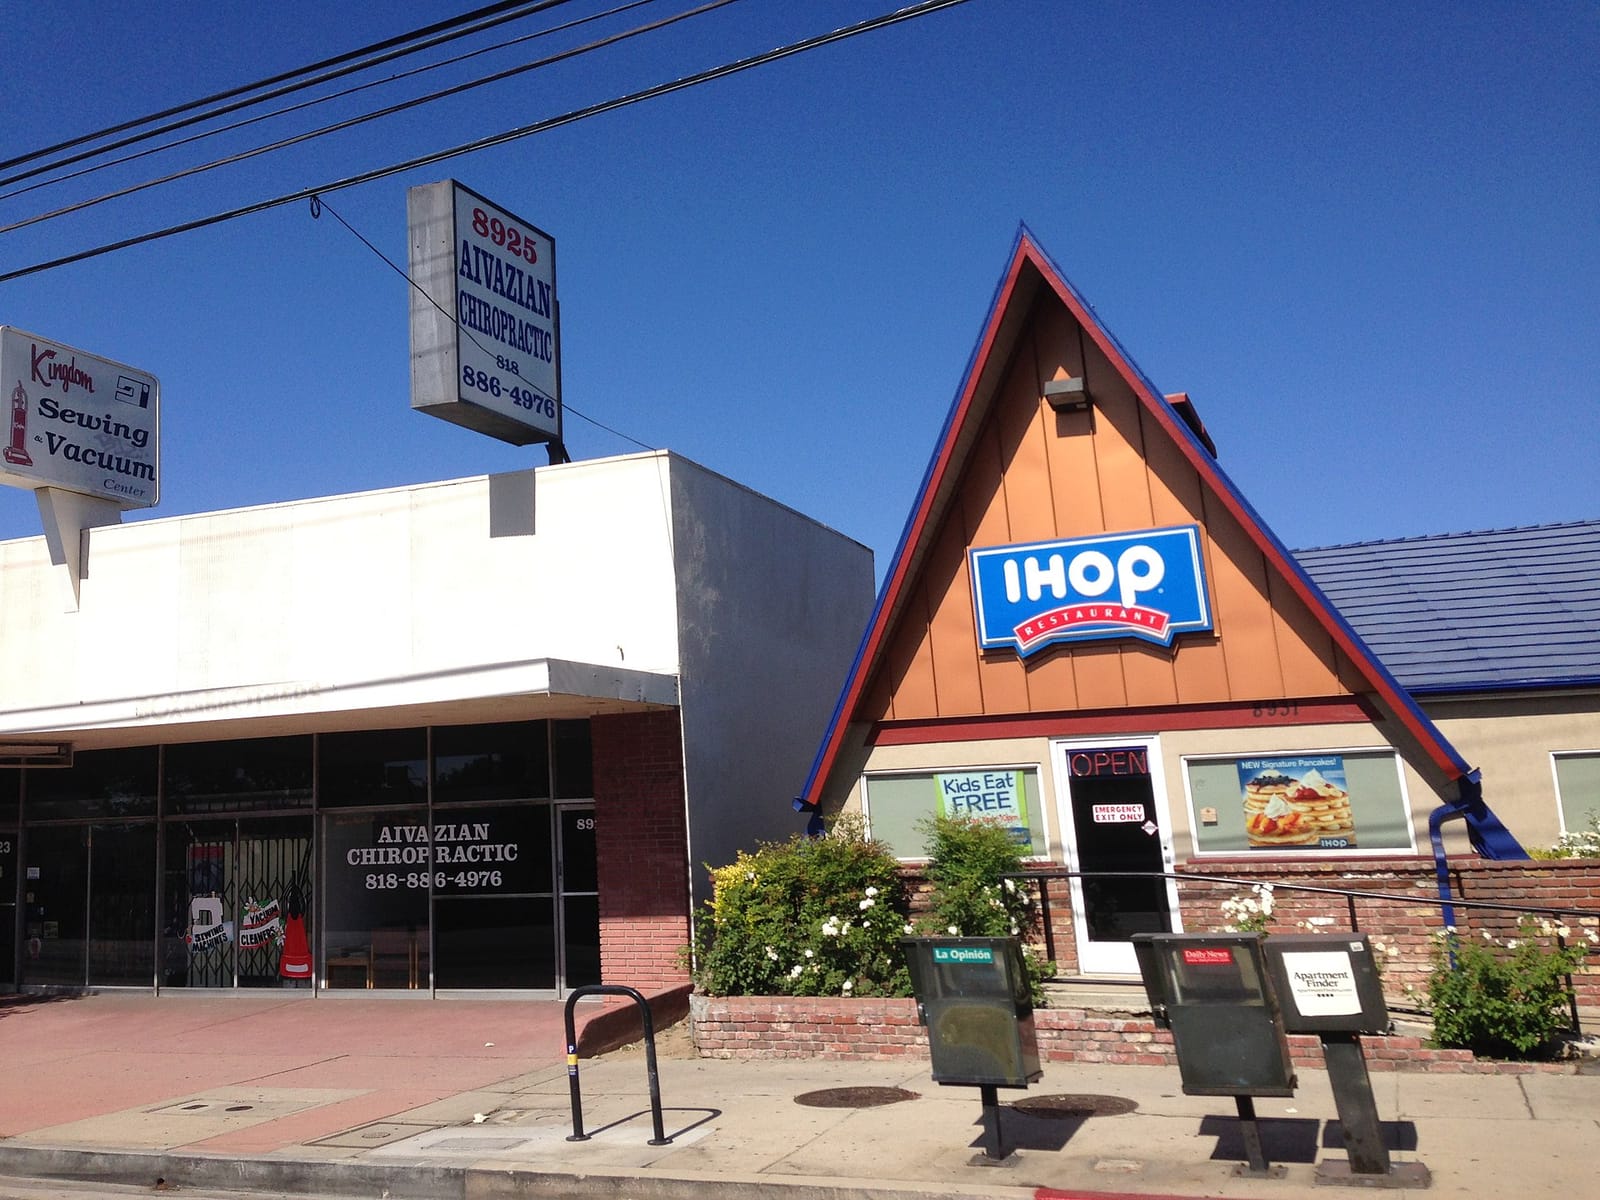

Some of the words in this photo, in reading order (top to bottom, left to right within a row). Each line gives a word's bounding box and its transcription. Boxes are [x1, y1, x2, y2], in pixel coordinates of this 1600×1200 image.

[472, 207, 538, 264] 8925
[459, 239, 551, 319] AIVAZIAN
[459, 290, 552, 364] CHIROPRACTIC
[31, 343, 95, 393] Kingdom
[496, 355, 519, 376] 818
[463, 365, 555, 419] 886-4976
[38, 398, 149, 448] Sewing
[45, 431, 155, 481] Vacuum
[104, 479, 145, 497] Center
[1004, 545, 1165, 608] IHOP
[1025, 608, 1156, 637] RESTAURANT
[1071, 752, 1147, 776] OPEN
[1241, 761, 1260, 769] NEW
[1262, 760, 1297, 769] Signature
[943, 777, 981, 794] Kids
[984, 773, 1013, 789] Eat
[952, 791, 1011, 813] FREE
[378, 824, 490, 843] AIVAZIAN
[1321, 839, 1347, 848] IHOP
[347, 844, 518, 865] CHIROPRACTIC
[365, 871, 502, 889] 818-886-4976
[241, 926, 276, 945] CLEANERS
[935, 949, 948, 959] La
[950, 949, 991, 961] Opinión
[1294, 972, 1349, 982] Apartment
[1306, 980, 1339, 988] Finder
